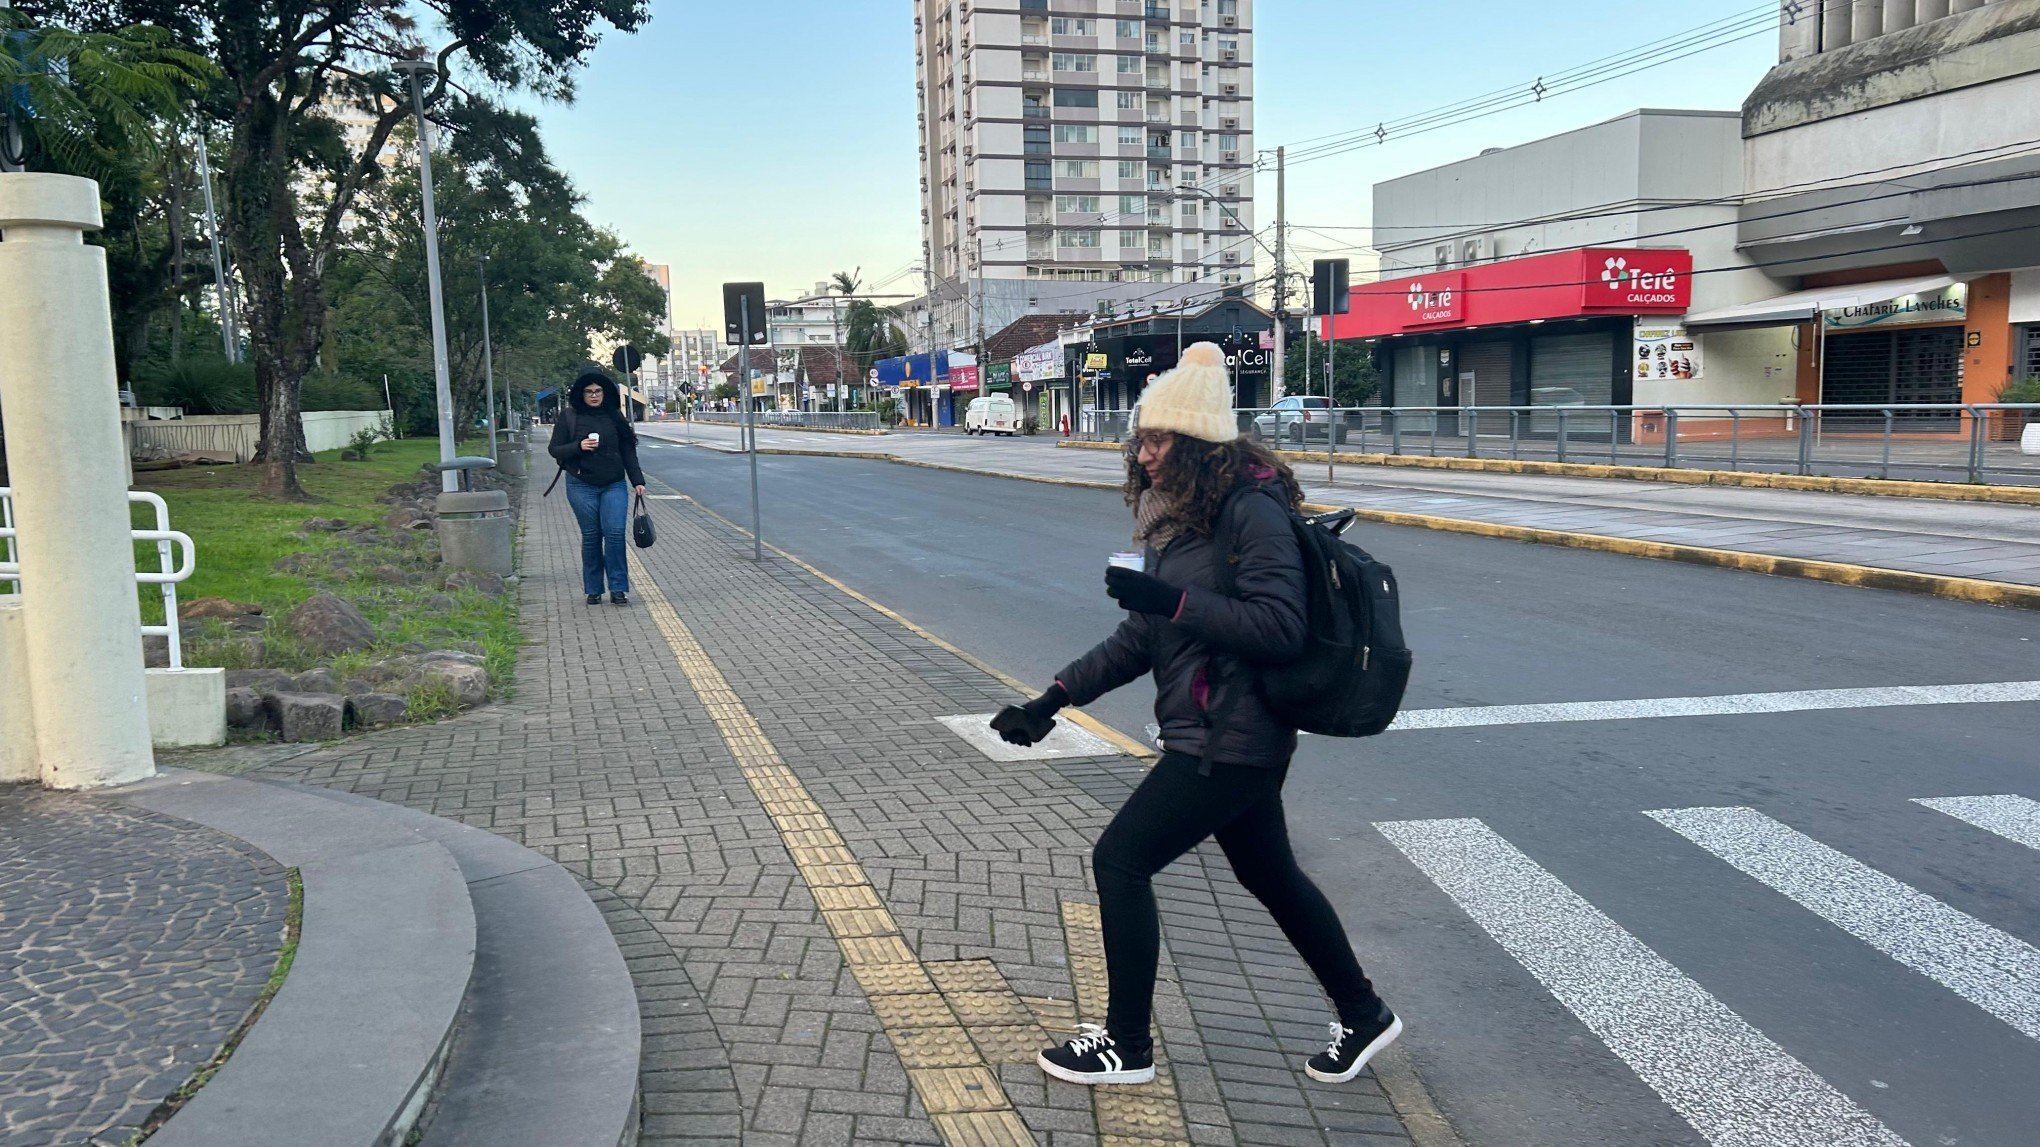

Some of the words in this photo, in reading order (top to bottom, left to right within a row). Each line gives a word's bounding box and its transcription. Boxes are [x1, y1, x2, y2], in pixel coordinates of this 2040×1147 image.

[1629, 267, 1676, 290] Terê
[1627, 293, 1675, 304] CALÇADOS
[1422, 310, 1451, 320] CALÇADOS
[1125, 356, 1152, 364] TotalCell
